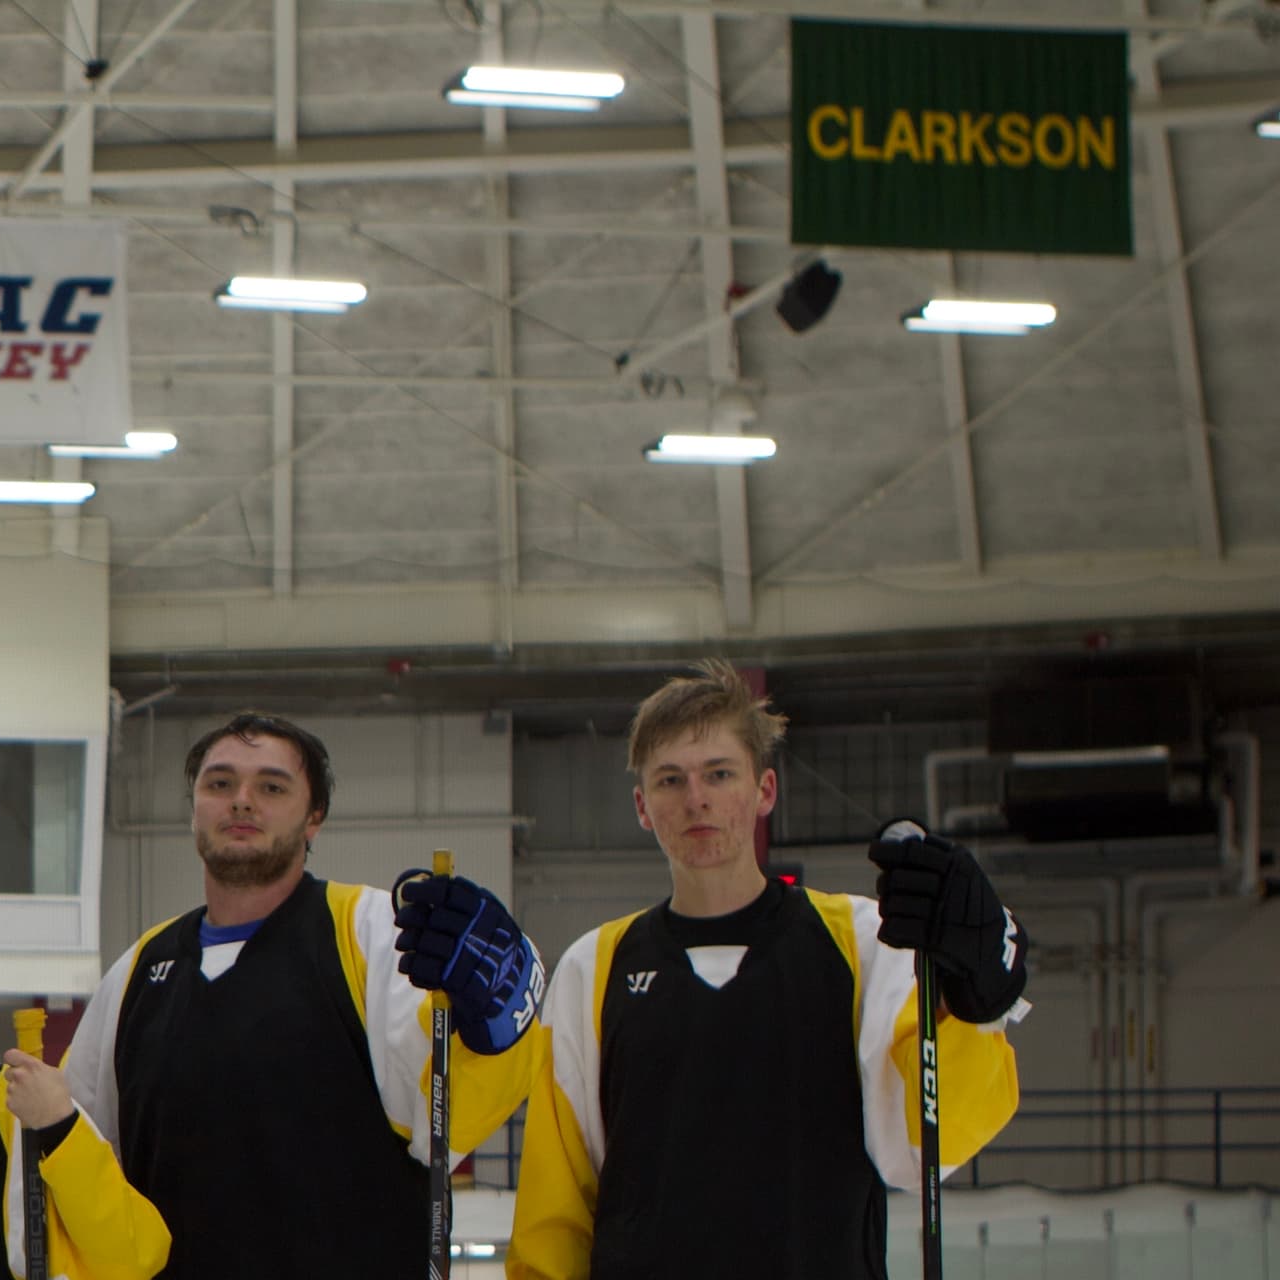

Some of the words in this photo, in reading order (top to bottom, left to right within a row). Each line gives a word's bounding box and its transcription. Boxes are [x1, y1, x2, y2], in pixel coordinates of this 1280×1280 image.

[807, 105, 1116, 170] CLARKSON
[433, 1073, 443, 1137] BAUER
[923, 1038, 938, 1125] CCM
